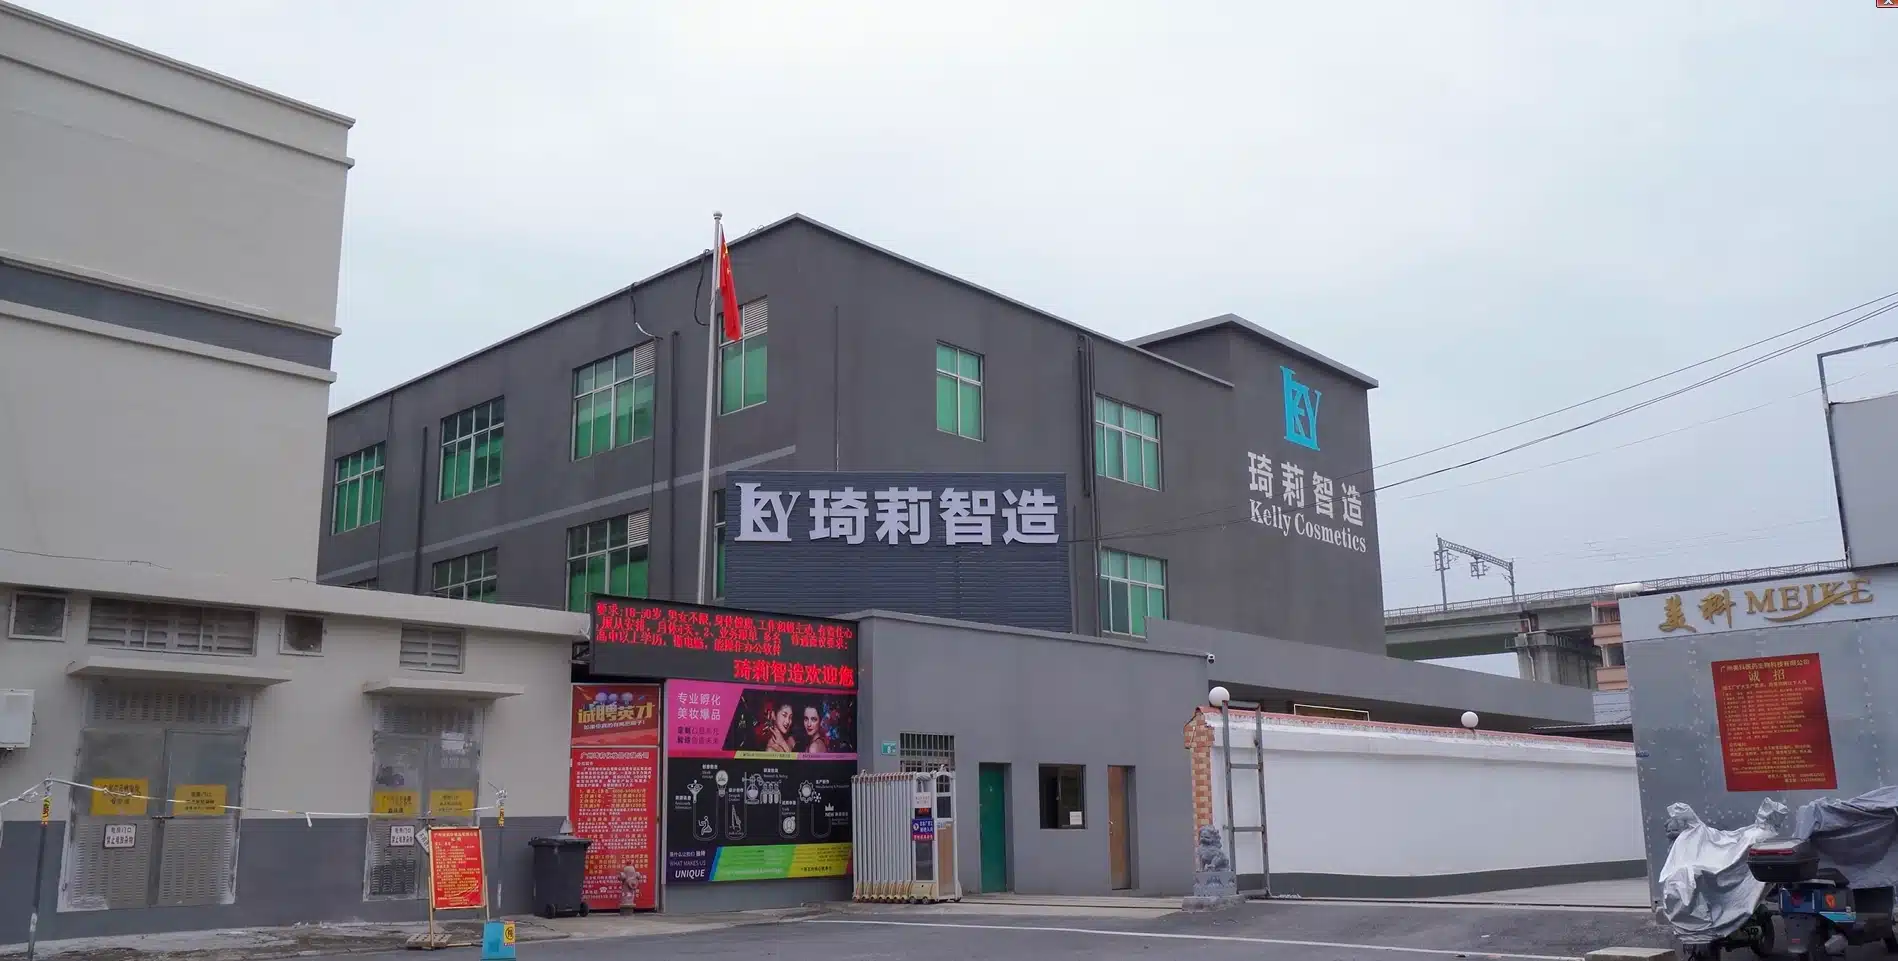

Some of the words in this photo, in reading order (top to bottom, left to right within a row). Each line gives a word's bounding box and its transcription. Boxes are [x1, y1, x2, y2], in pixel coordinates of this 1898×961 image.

[1247, 451, 1364, 527] 琦莉智造
[808, 486, 1060, 545] 琦莉智造
[1249, 498, 1292, 537] Kelly
[1295, 512, 1367, 553] Cosmetics
[1658, 588, 1736, 633] 美科
[1744, 578, 1874, 621] MEIKE
[733, 658, 855, 688] 琦莉智造欢迎您
[1773, 668, 1785, 681] 招
[577, 702, 653, 724] 诚聘英才
[677, 692, 721, 706] 专业孵化
[677, 707, 721, 720] 美妆爆品
[674, 869, 706, 880] UNIQUE
